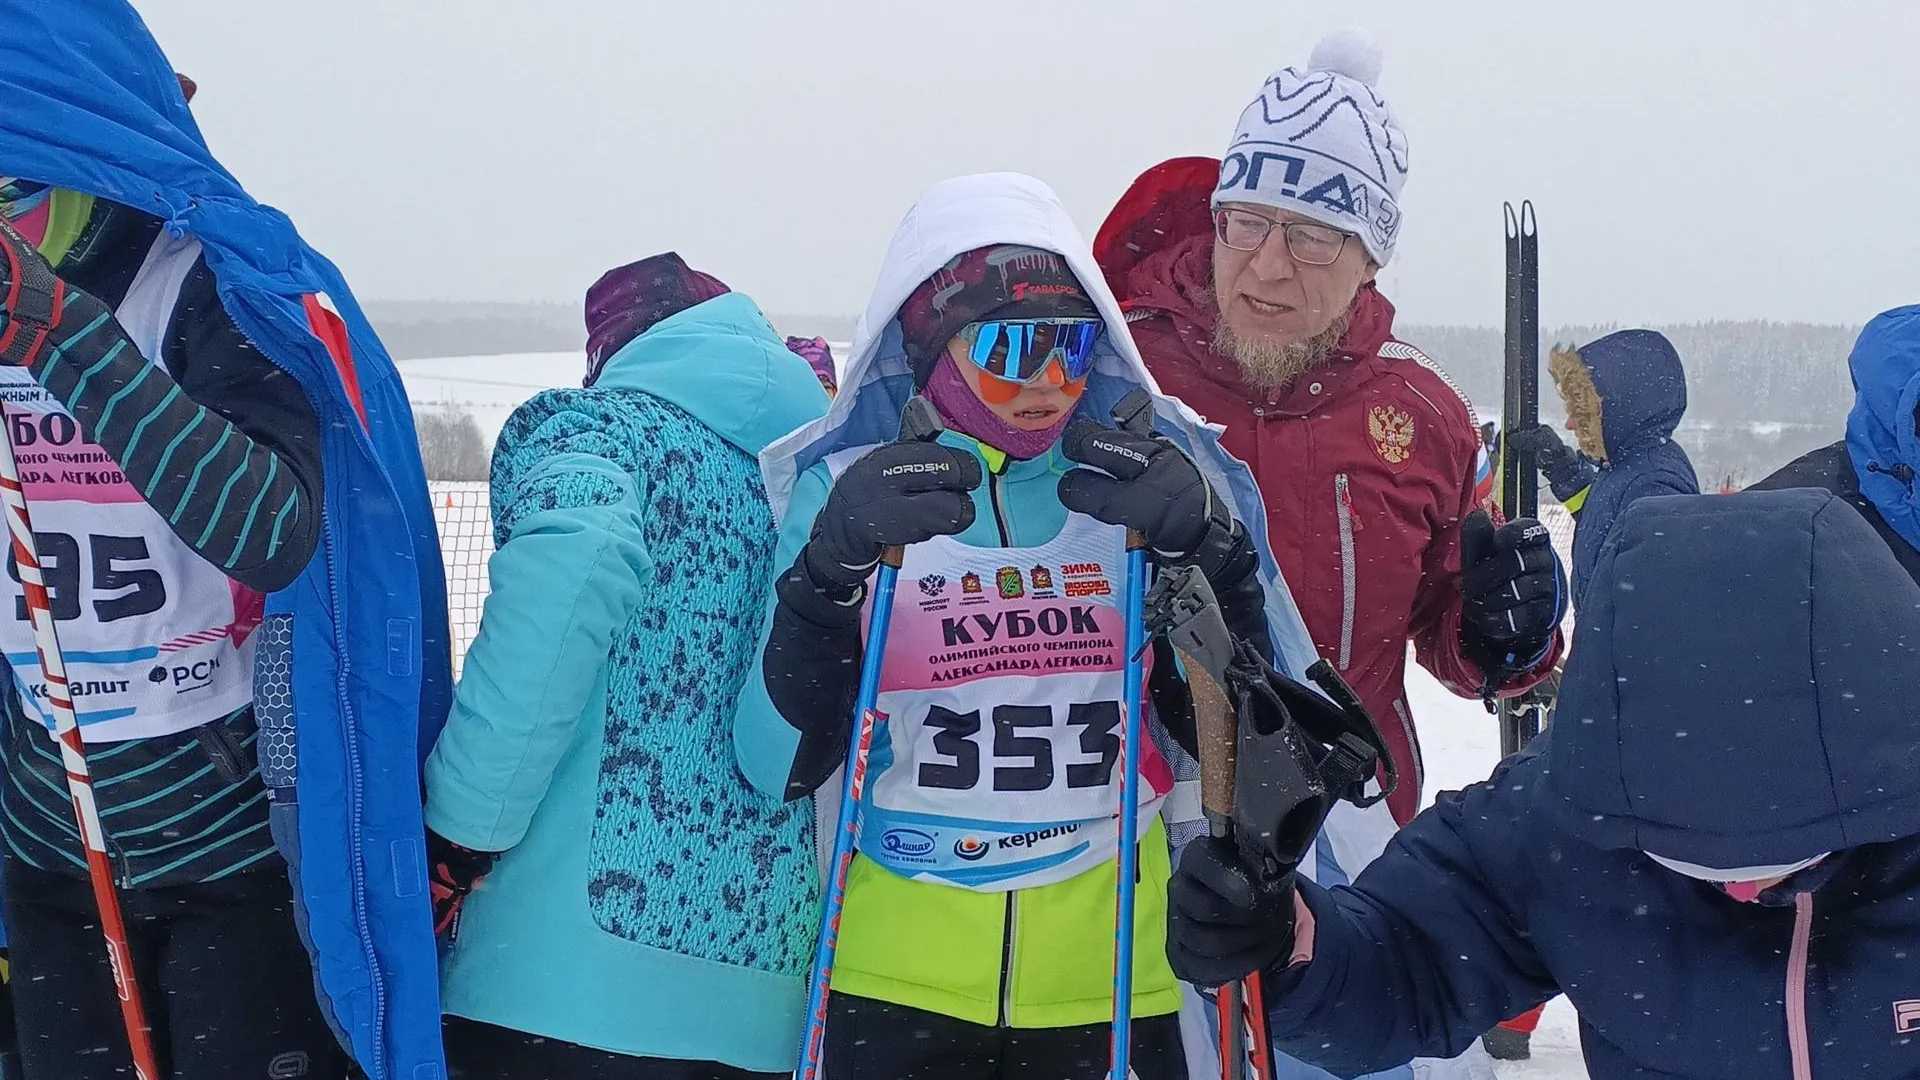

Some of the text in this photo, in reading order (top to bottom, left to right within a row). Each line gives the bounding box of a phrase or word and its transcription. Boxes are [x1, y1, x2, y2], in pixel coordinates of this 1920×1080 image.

[61, 470, 130, 485] ЛЕГКОВ
[882, 463, 949, 476] NORDSKI
[942, 605, 1100, 647] КУБОК
[929, 638, 1114, 665] ОЛИМПИЙСКОГО ЧЕМПИОНА
[930, 654, 1114, 683] АЛЕКСАНДРА ЛЕГКОВА
[30, 679, 130, 698] кеалит
[918, 700, 1121, 792] 353
